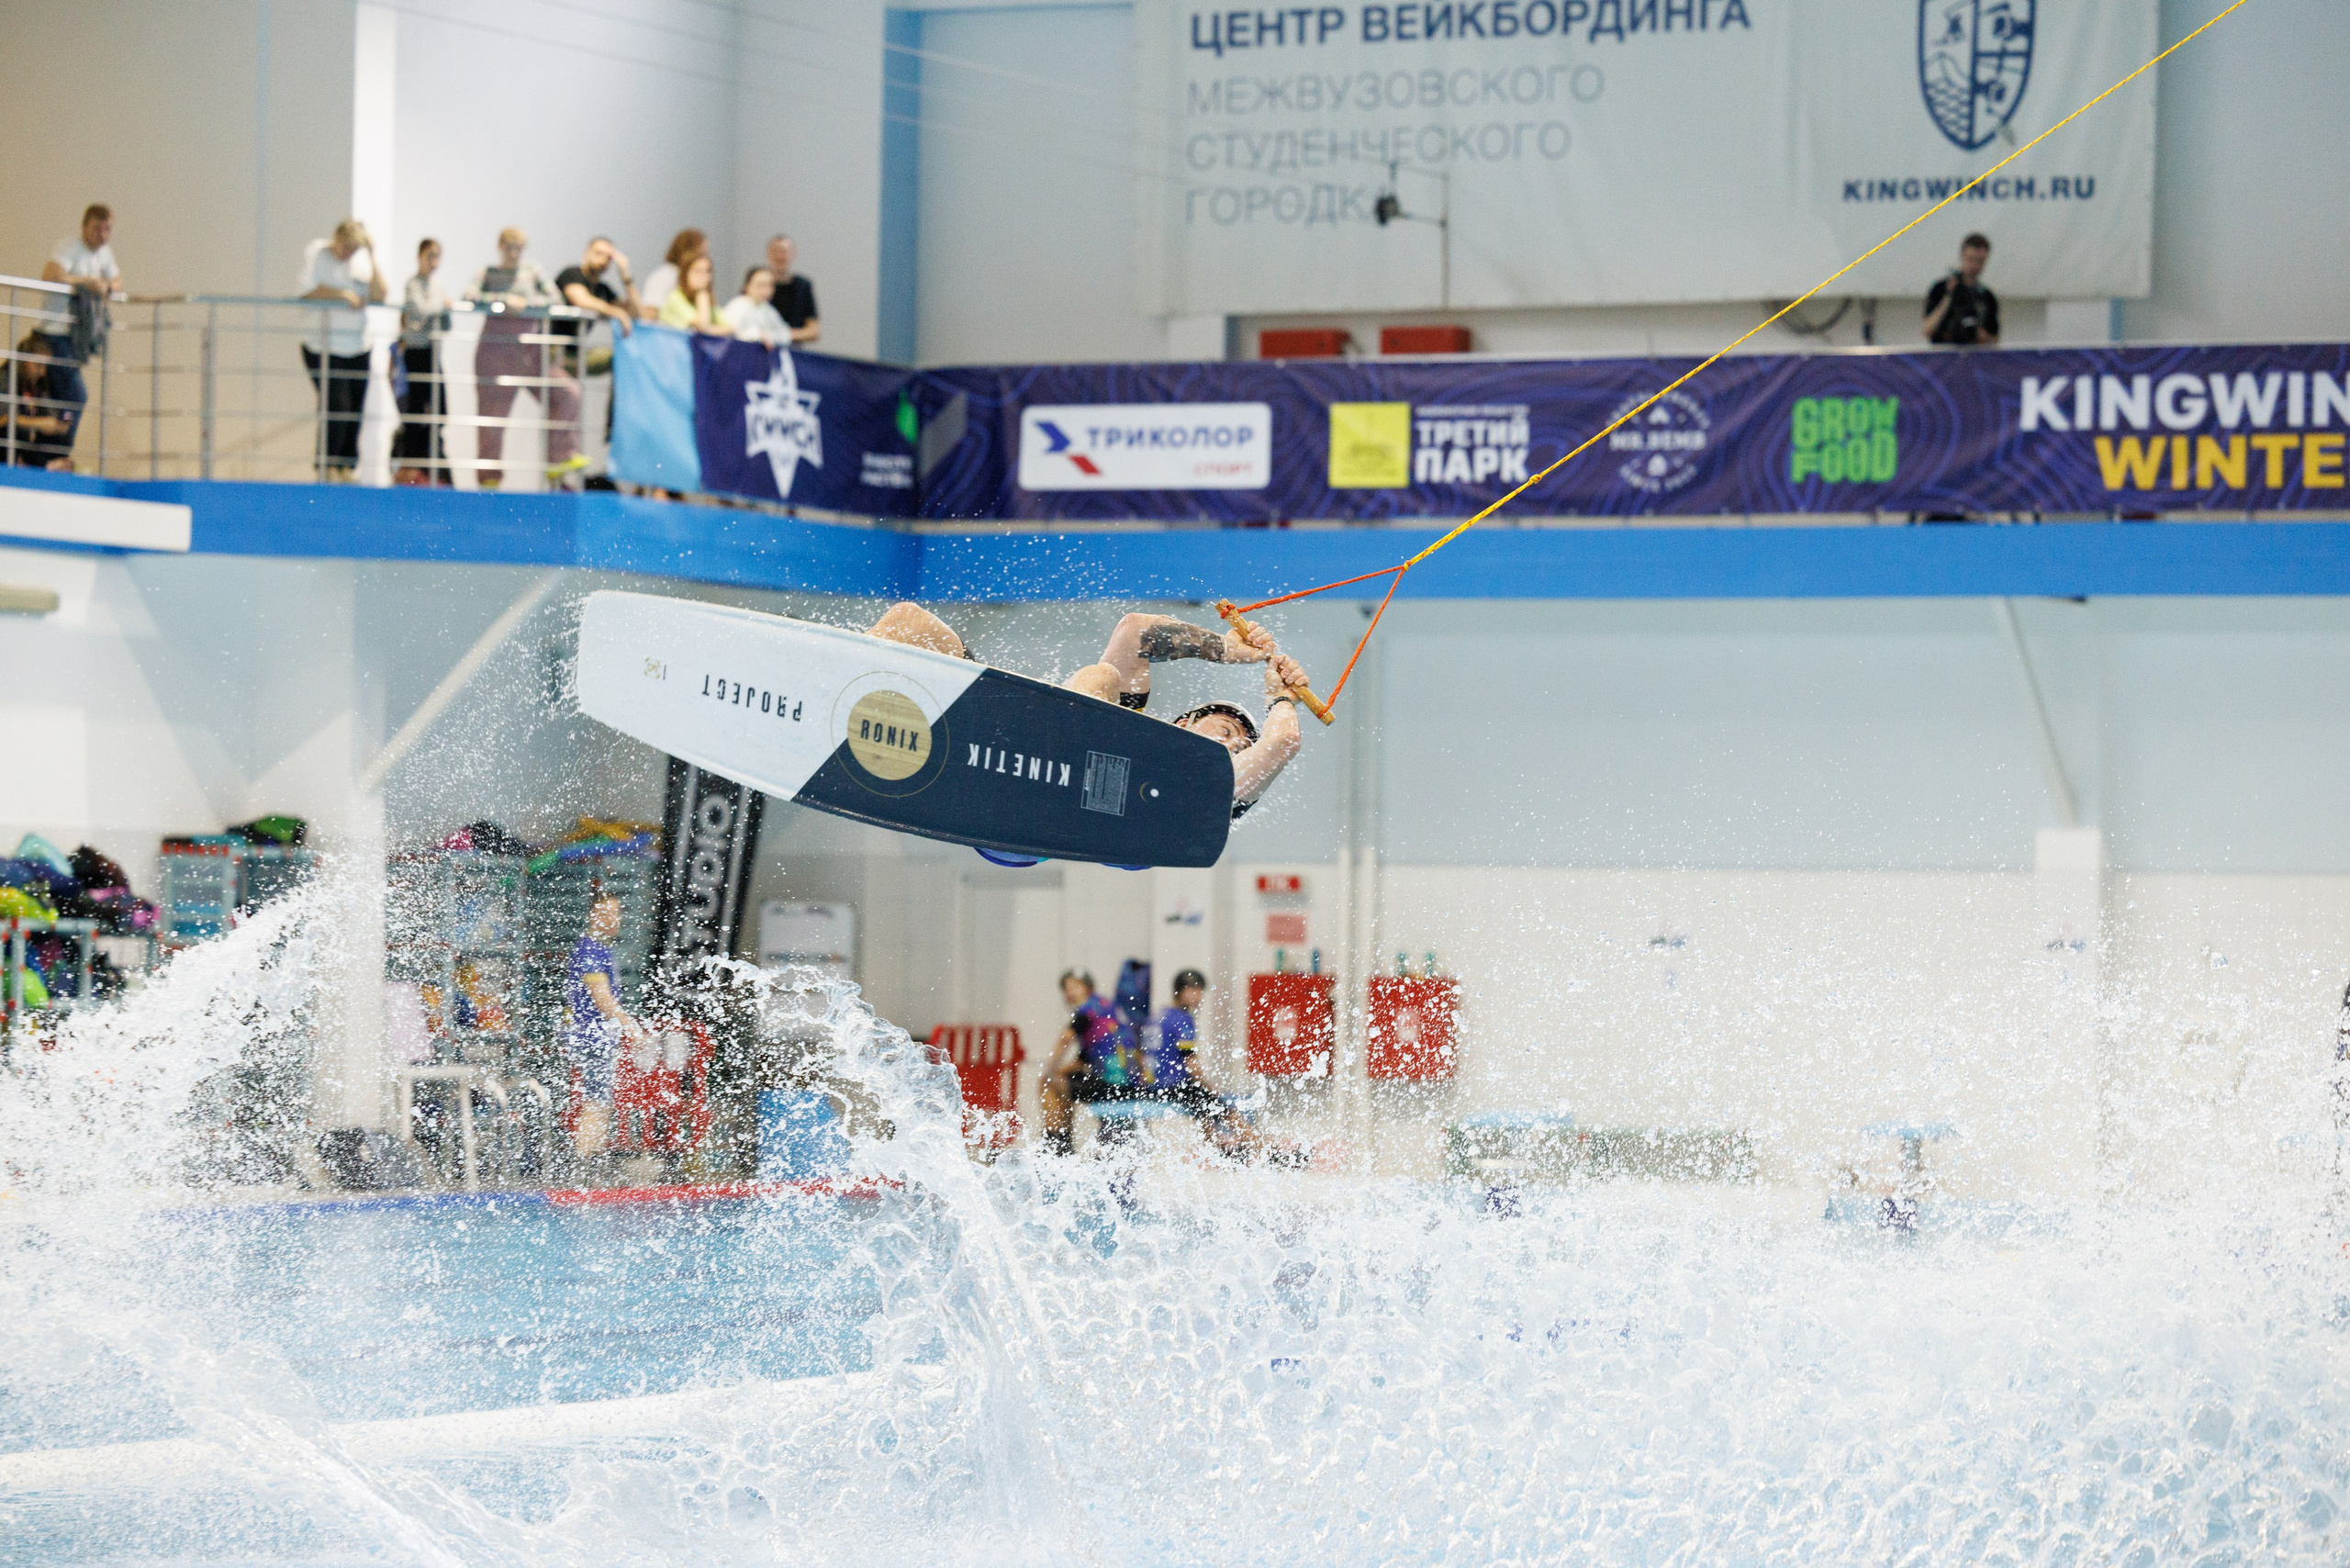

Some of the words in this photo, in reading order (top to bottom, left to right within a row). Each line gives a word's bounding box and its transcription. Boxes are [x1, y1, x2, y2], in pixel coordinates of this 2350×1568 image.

[1191, 6, 1347, 57] ЦЕНТР
[1186, 63, 1607, 116] МЕЖВУЗОВСКОГО
[1185, 119, 1573, 174] СТУДЕНЧЕСКОГО
[1184, 183, 1390, 228] ГОРОДК
[1842, 176, 2097, 203] KINGWINCH.RU
[1088, 426, 1254, 449] ТРИКОЛОР
[1416, 417, 1530, 446] ТРЕТИЙ
[1791, 396, 1899, 450] GROW
[1416, 446, 1529, 484] ПАРК
[1791, 430, 1898, 485] FOOD
[701, 674, 803, 722] PROJECT
[860, 719, 918, 752] RONIX
[967, 734, 1071, 787] KINETIK
